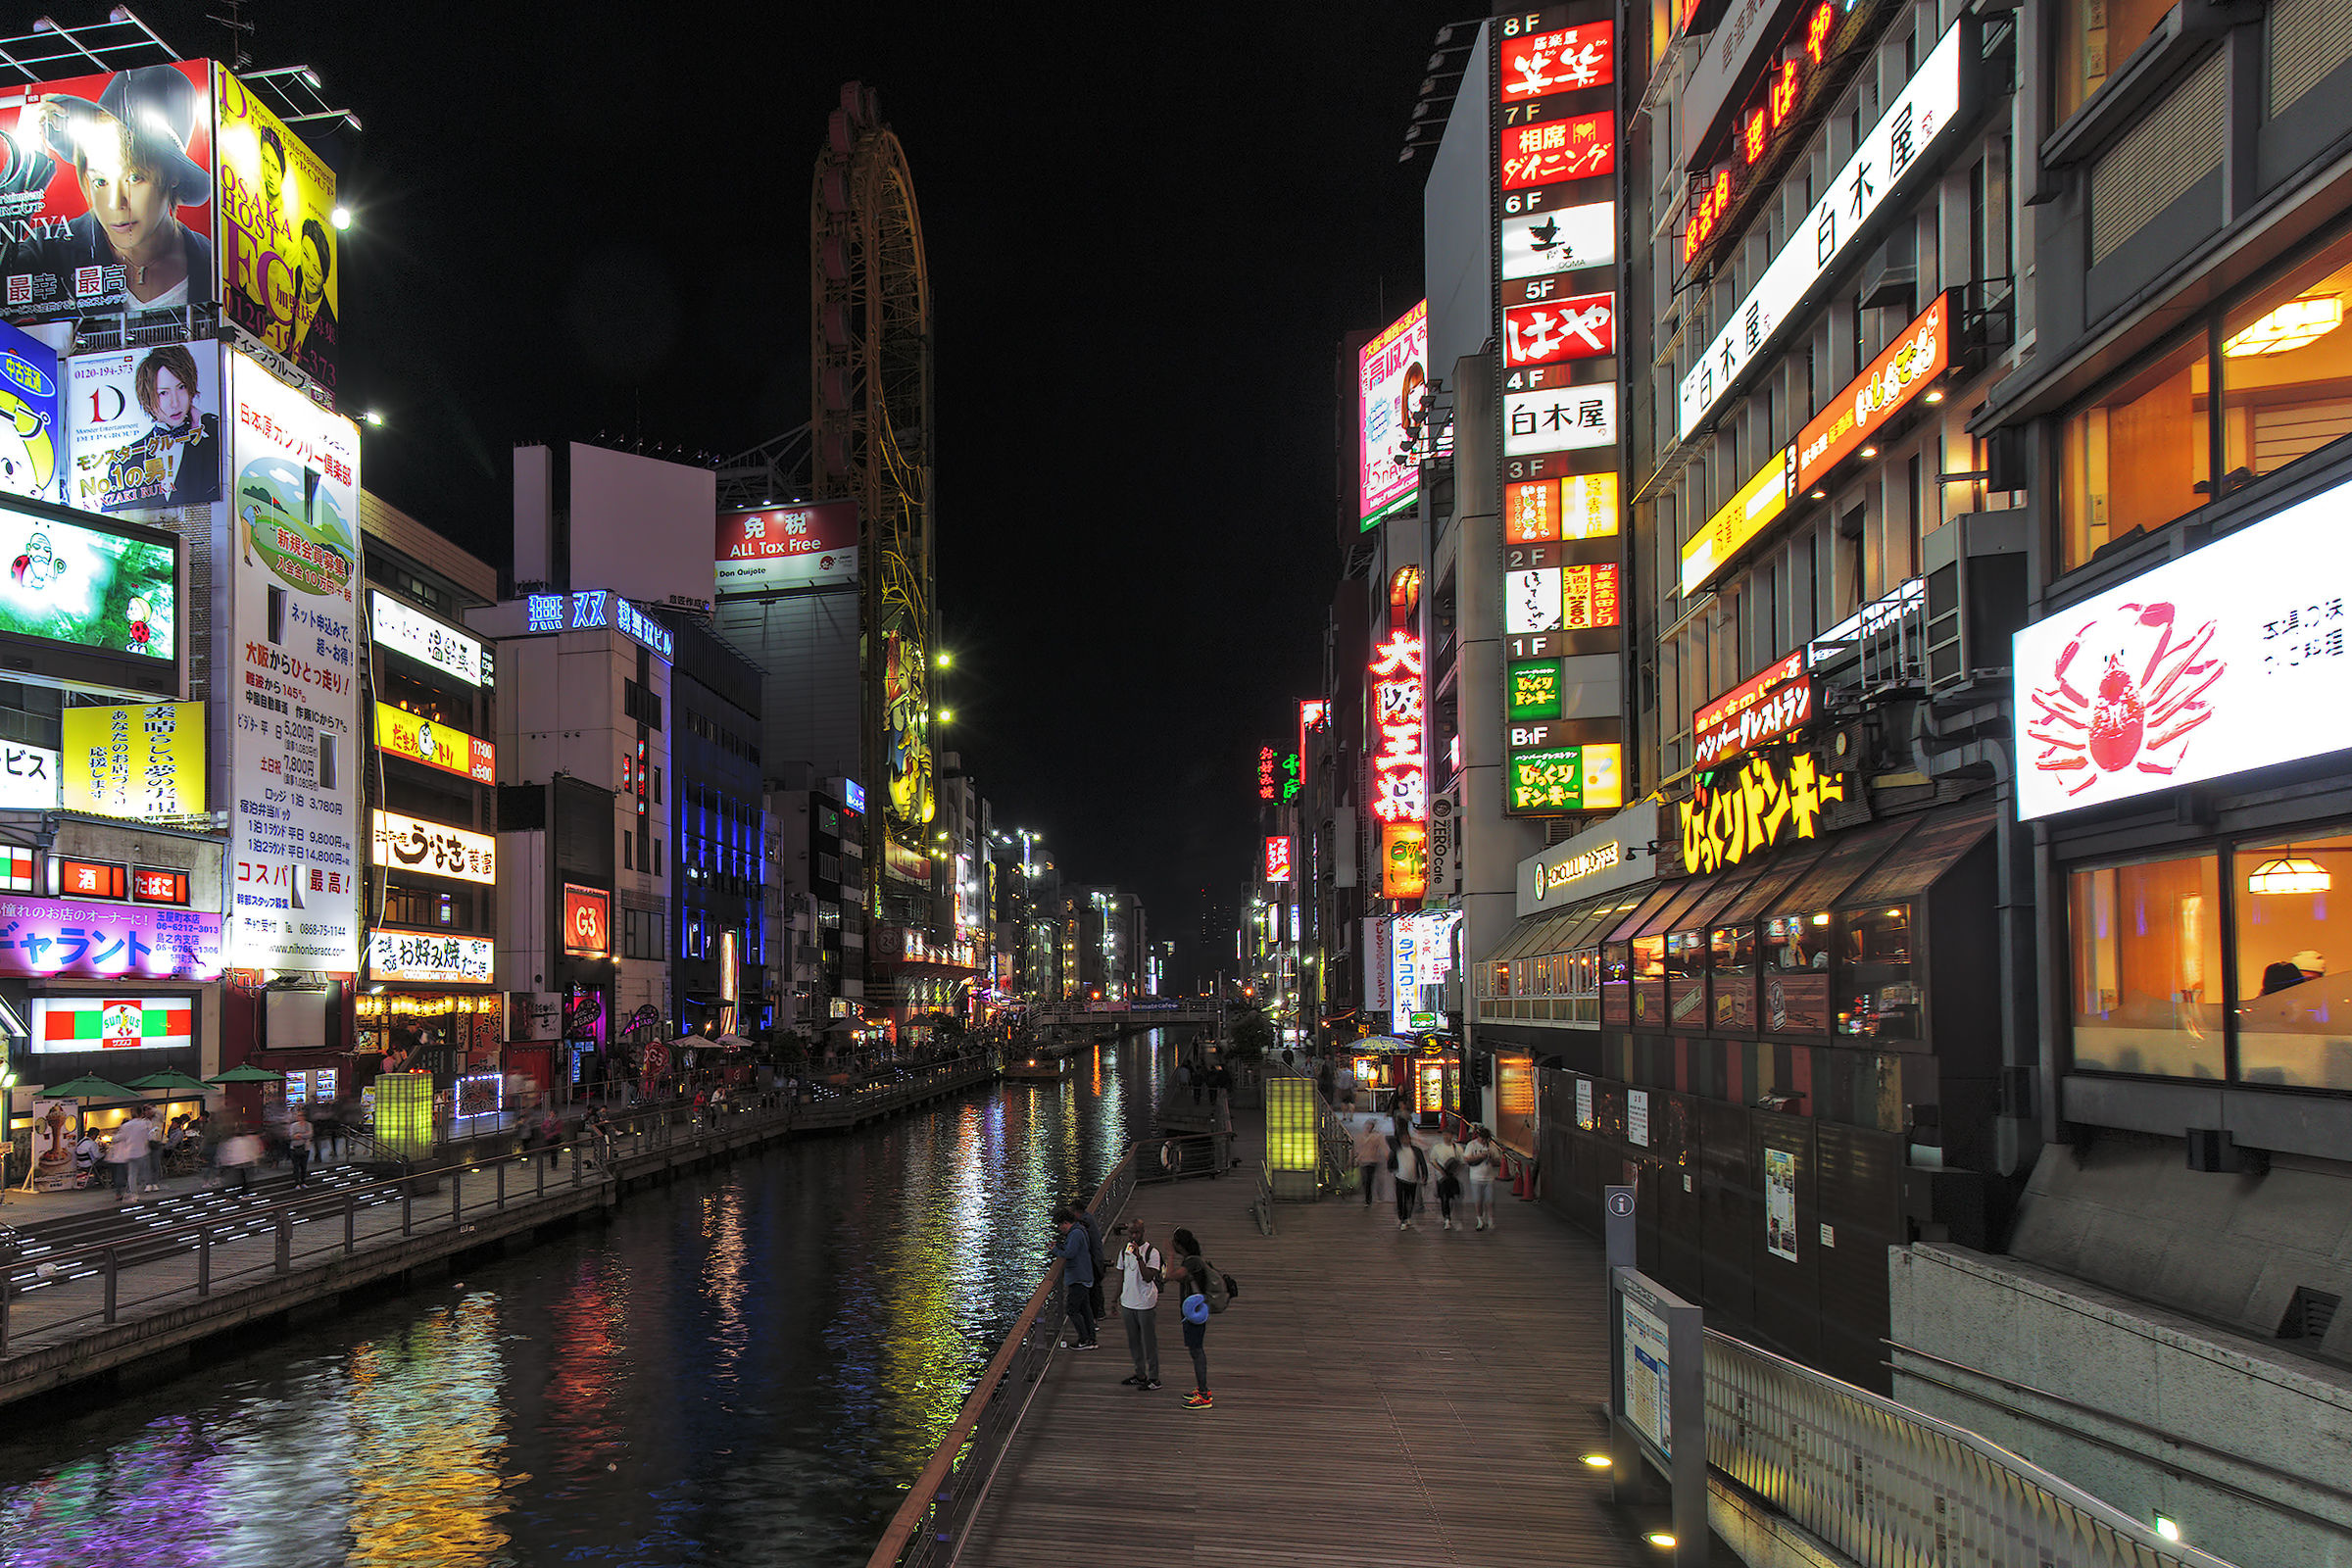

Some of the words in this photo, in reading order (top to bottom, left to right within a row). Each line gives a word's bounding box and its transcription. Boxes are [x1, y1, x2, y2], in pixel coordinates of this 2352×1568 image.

[1503, 13, 1540, 36] 8F
[1504, 103, 1540, 124] 7F
[1519, 124, 1566, 154] 相席
[1503, 143, 1611, 185] ダイニング
[1818, 101, 1915, 270] 白木屋
[1504, 191, 1543, 214] 6F
[1526, 279, 1555, 299] 5F
[1507, 303, 1610, 362] はや
[1700, 300, 1762, 413] 白木屋
[1507, 369, 1544, 390] 4F
[1511, 400, 1607, 437] 白木屋
[77, 425, 205, 470] モンスターグループ
[1509, 459, 1544, 479] 3F
[744, 512, 807, 539] 免税
[276, 527, 354, 580] 新規会員募集!
[730, 544, 755, 558] ALL
[759, 541, 785, 555] Tax
[789, 538, 821, 552] Free
[1510, 549, 1544, 567] 2F
[737, 567, 766, 576] Quijote
[1512, 637, 1546, 657] 1F
[1369, 631, 1422, 821] 大阪王将
[1511, 727, 1548, 746] B1F
[1695, 687, 1810, 762] ハンバーグレストラン
[472, 739, 493, 759] 17:00
[1518, 763, 1576, 786] びっくり
[1515, 784, 1579, 808] ドンキー
[1680, 753, 1843, 875] びっくりドンキー
[1434, 820, 1447, 857] ZERO
[78, 868, 96, 890] 酒
[238, 861, 289, 886] コスパ
[1434, 858, 1445, 884] cafe
[134, 875, 174, 897] たばこ
[576, 906, 597, 937] G3
[399, 937, 460, 969] お好み焼
